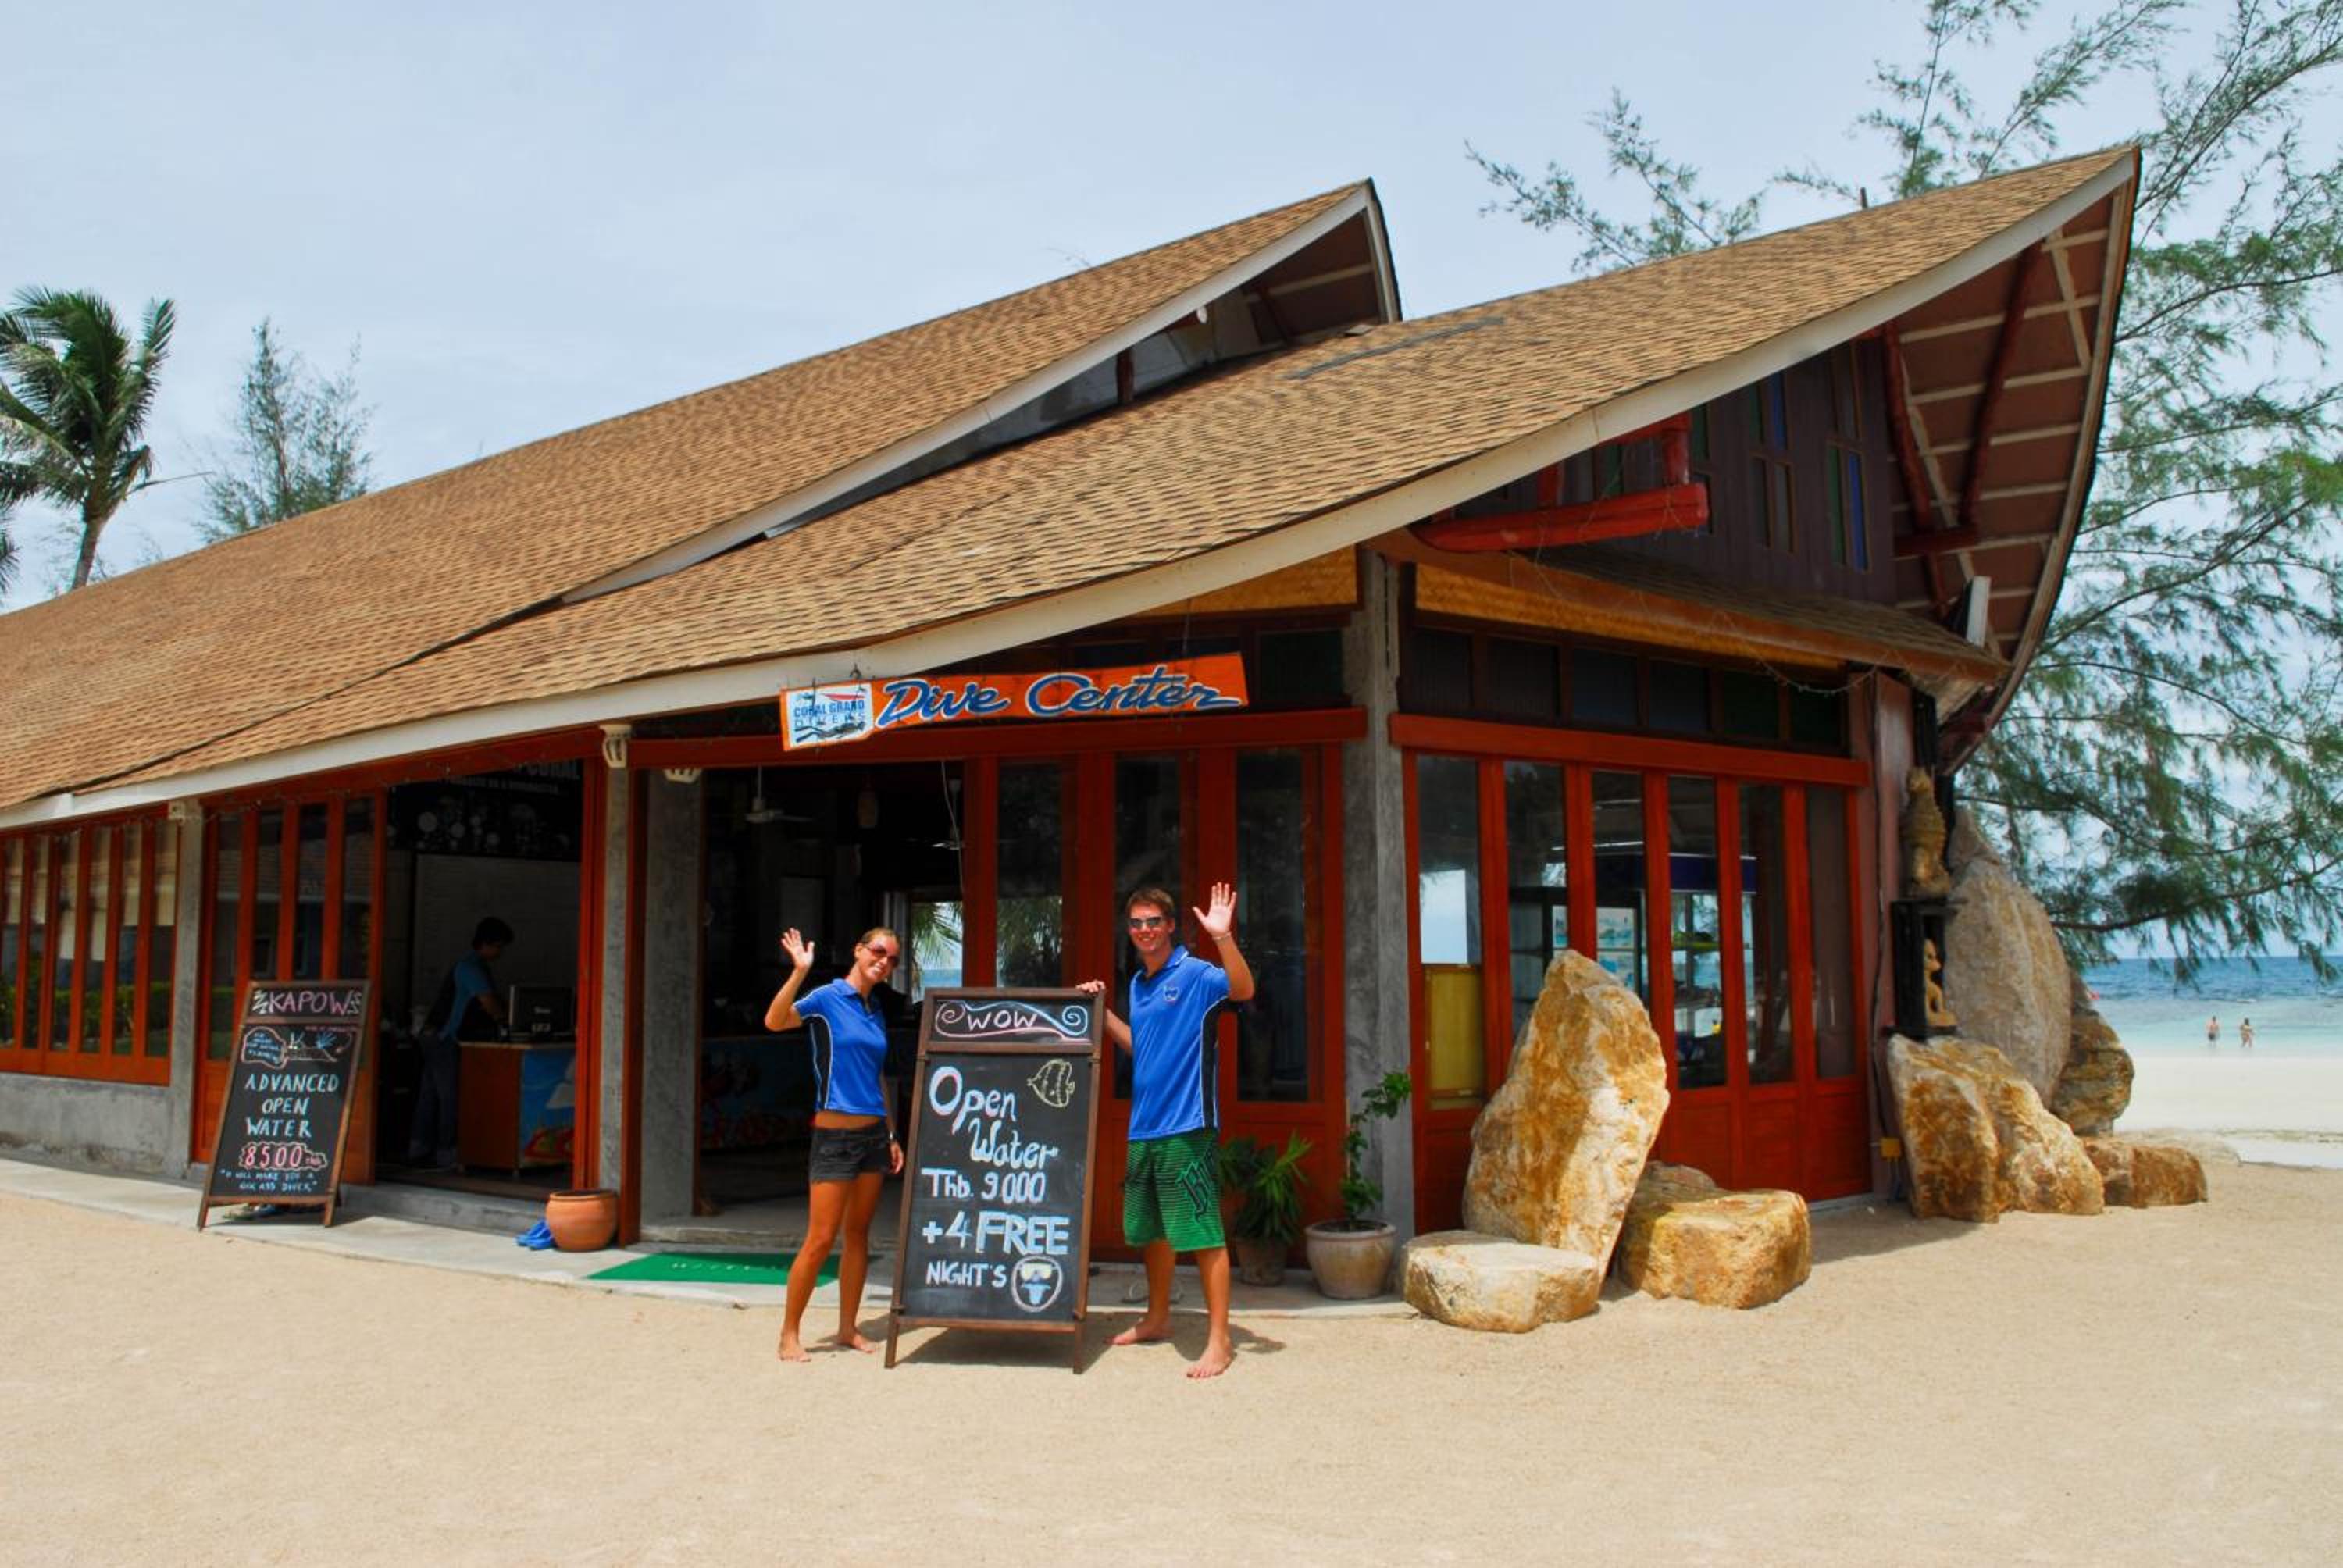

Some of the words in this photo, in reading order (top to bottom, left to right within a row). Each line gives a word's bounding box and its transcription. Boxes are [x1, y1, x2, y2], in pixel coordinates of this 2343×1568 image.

[829, 700, 865, 713] GRAND
[876, 679, 1011, 728] Dive
[1024, 663, 1243, 719] Center
[968, 1009, 1039, 1031] WOW
[245, 1074, 339, 1092] ADVANCED
[262, 1097, 310, 1115] OPEN
[929, 1066, 1017, 1134] Open
[246, 1118, 312, 1137] WATER
[968, 1118, 1060, 1170] Water
[245, 1146, 302, 1167] 8500
[975, 1211, 1070, 1255] FREE
[926, 1260, 1007, 1288] NIGHT'S
